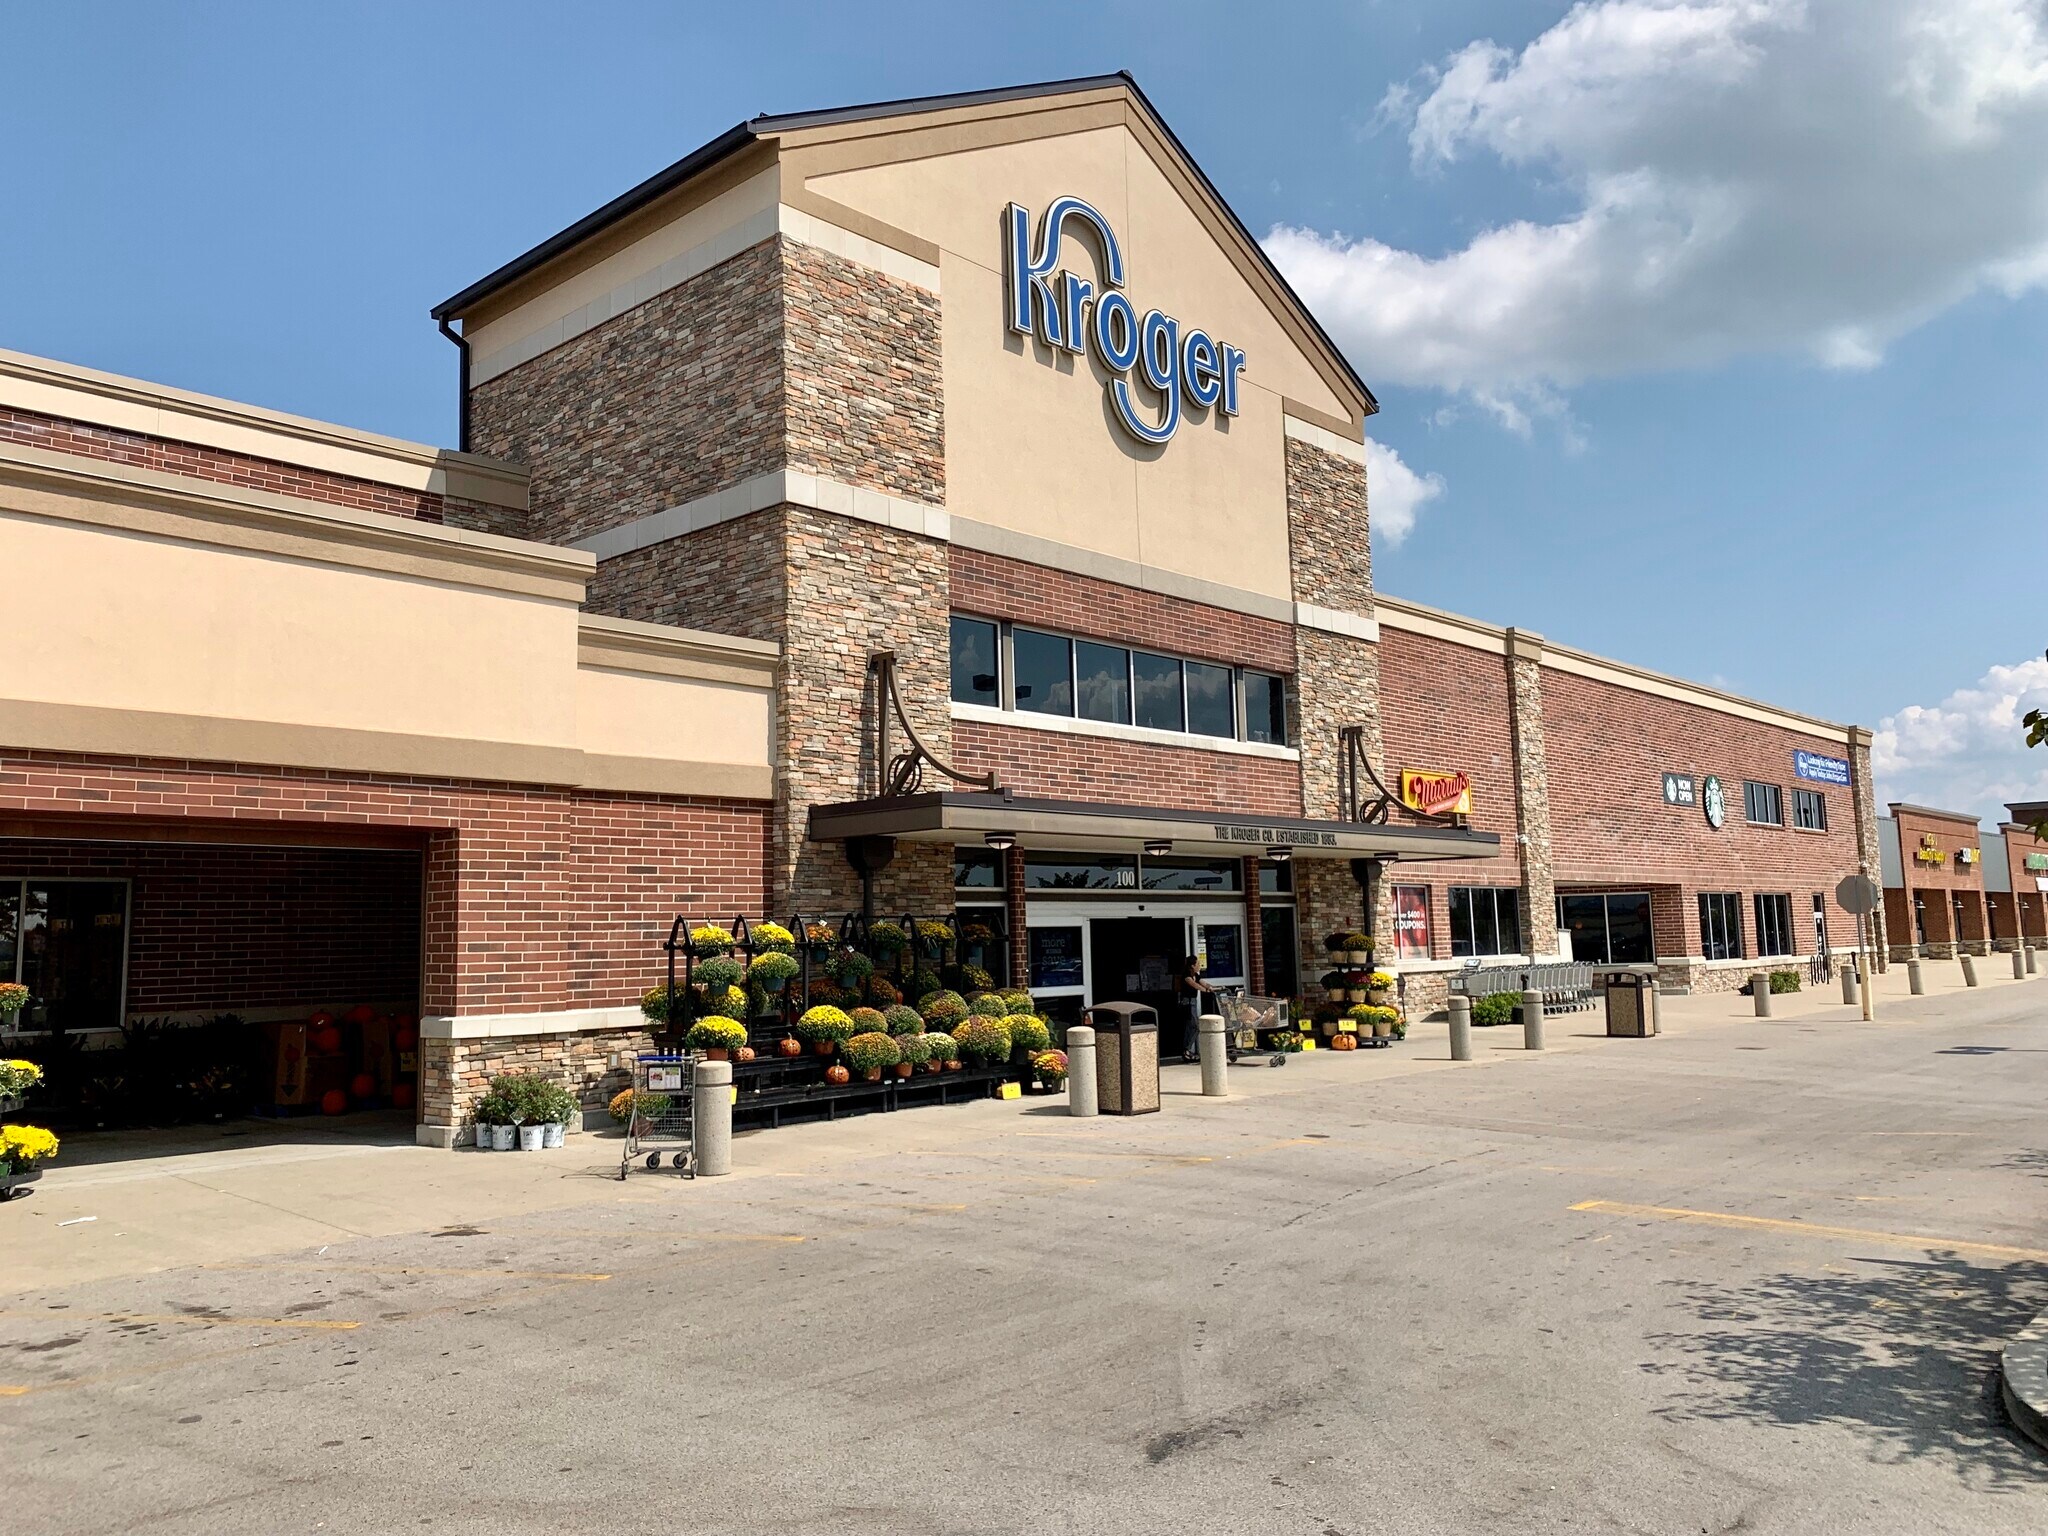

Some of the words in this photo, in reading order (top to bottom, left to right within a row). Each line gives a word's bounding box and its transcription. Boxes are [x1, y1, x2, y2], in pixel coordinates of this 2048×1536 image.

[1004, 195, 1246, 444] Kroger
[1677, 779, 1691, 791] NOW
[1678, 791, 1693, 802] OPEN
[1214, 826, 1229, 840] THE
[1231, 827, 1260, 841] KROGER
[1262, 830, 1274, 842] CO.
[1276, 830, 1319, 845] ESTABLISHED
[1116, 871, 1135, 886] 100
[1041, 938, 1066, 948] more
[1041, 955, 1066, 966] save
[1210, 950, 1230, 960] save
